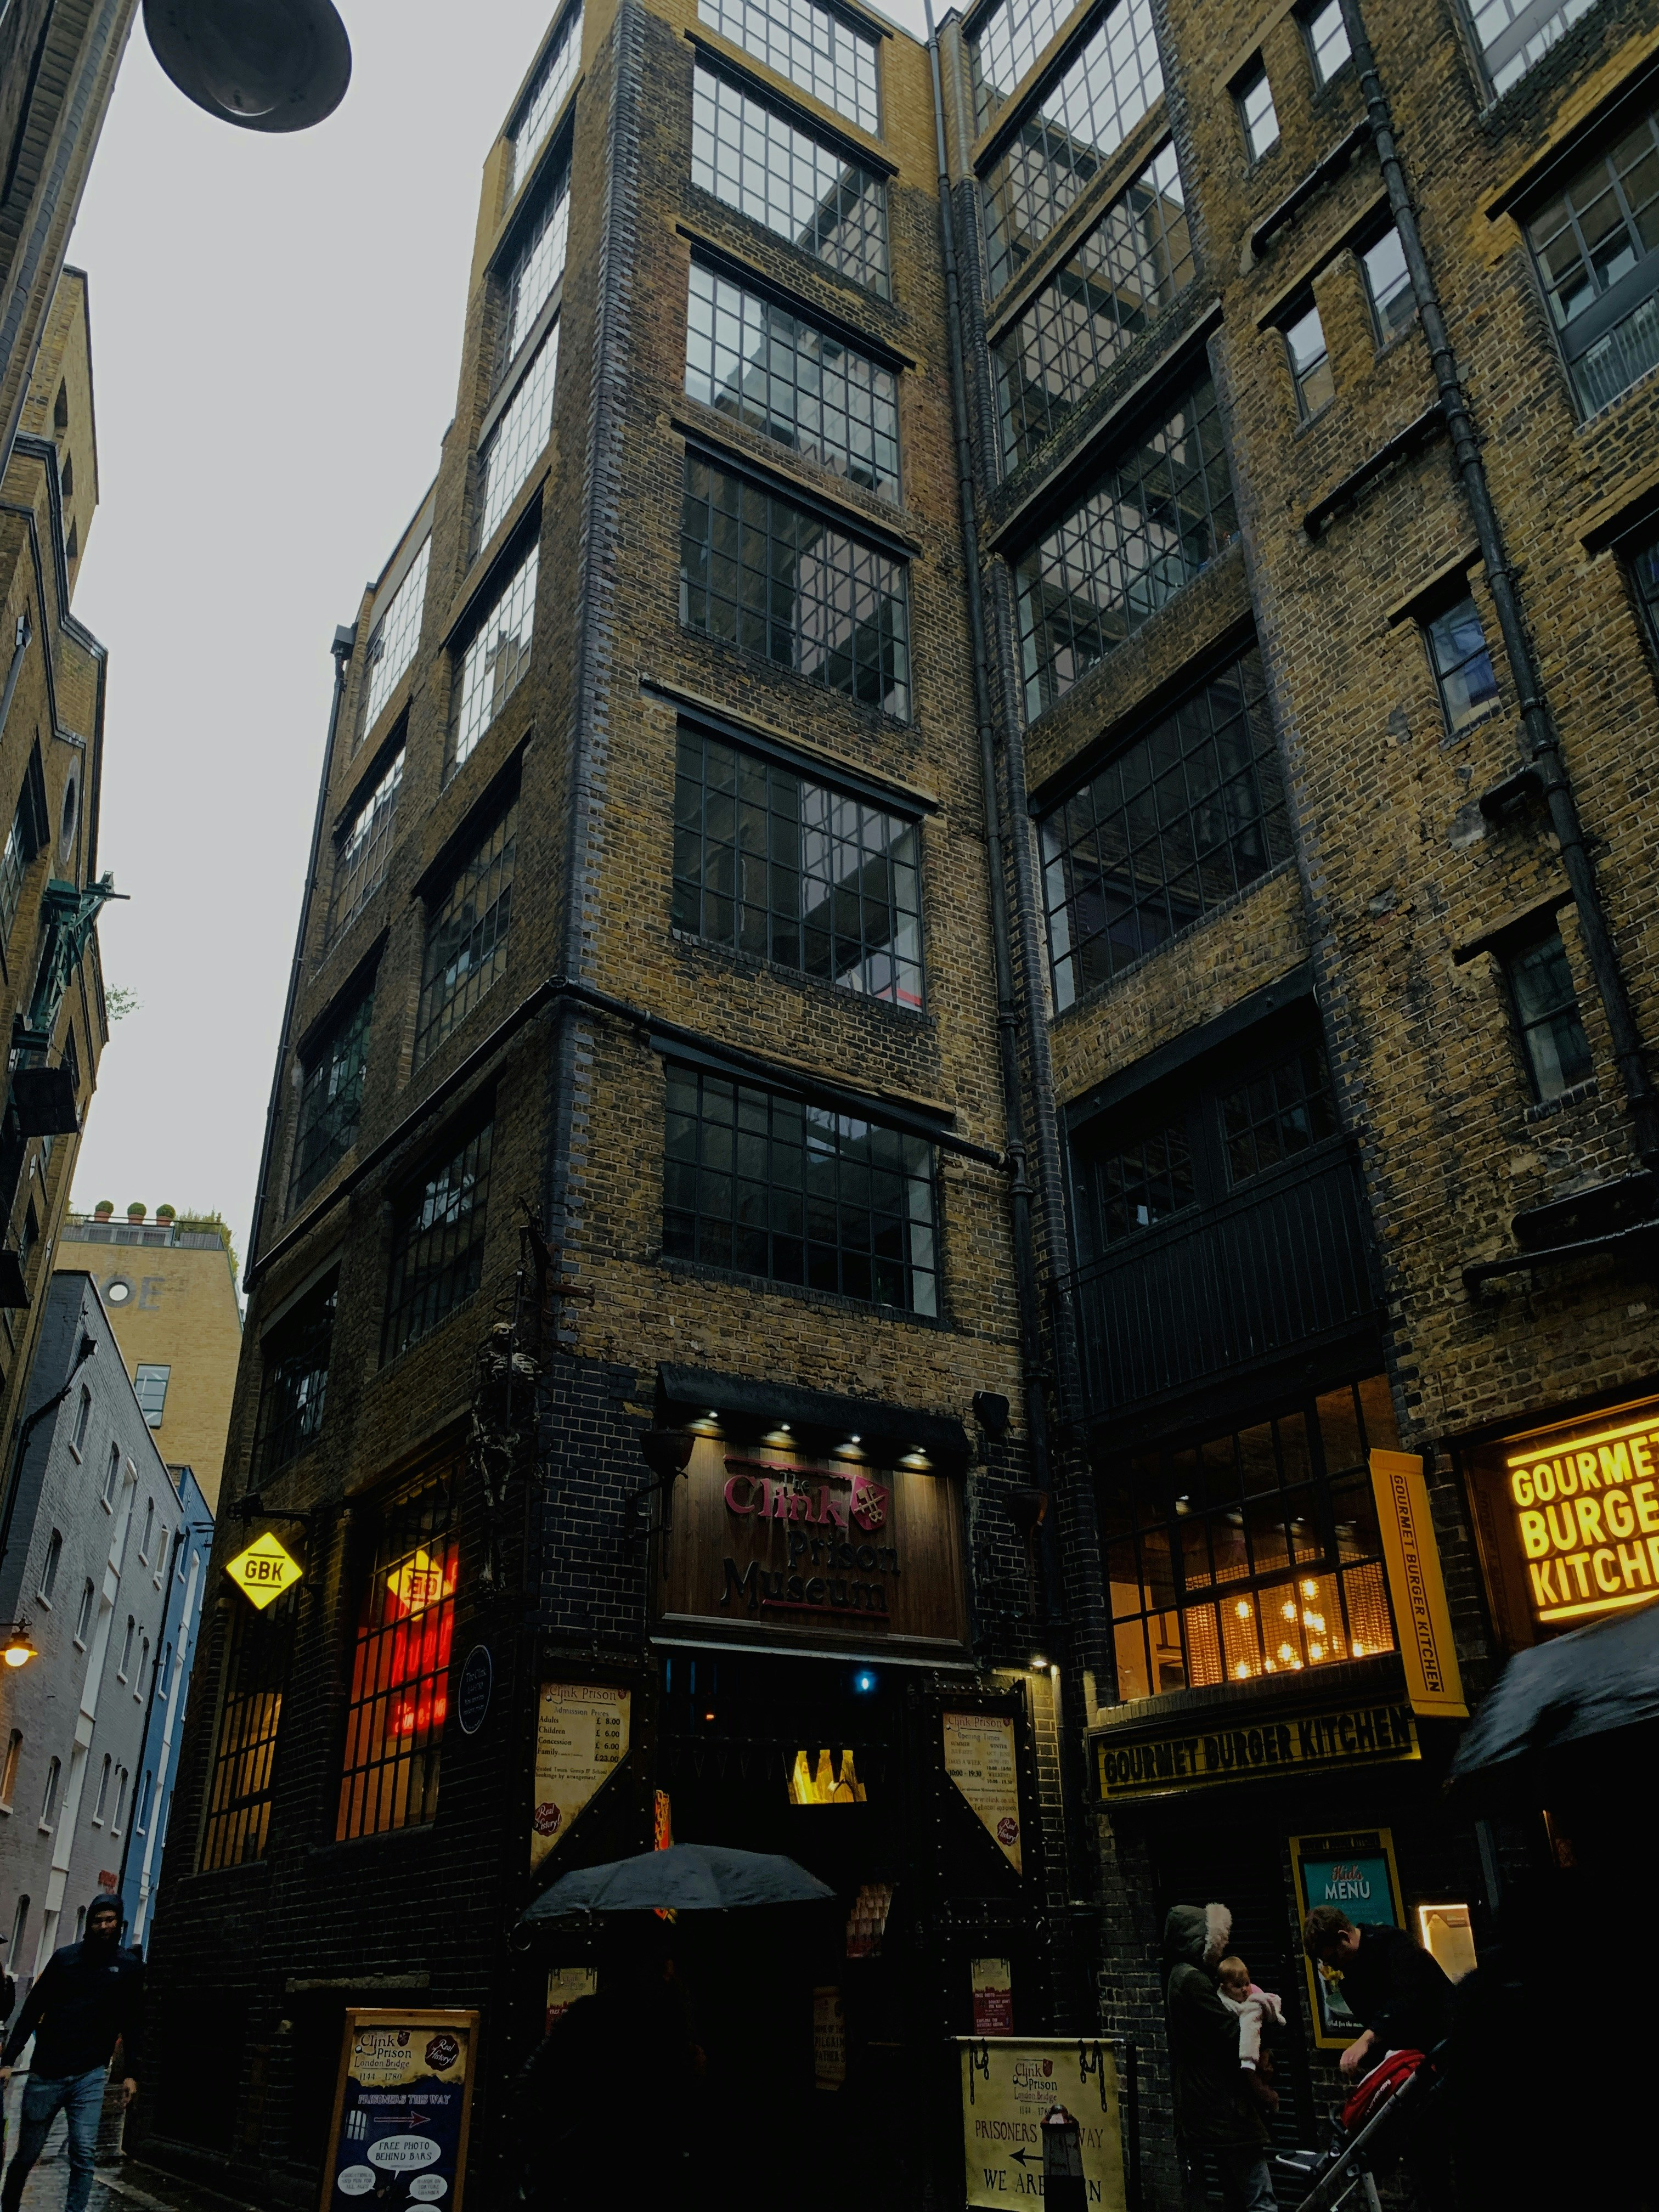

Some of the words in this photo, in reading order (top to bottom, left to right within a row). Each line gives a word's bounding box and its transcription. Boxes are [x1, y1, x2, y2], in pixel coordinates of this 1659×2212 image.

[94, 1274, 165, 1310] OE
[780, 1472, 809, 1490] The
[724, 1475, 848, 1527] Clink
[1519, 1481, 1659, 1558] BURGE
[788, 1530, 901, 1575] Prison
[245, 1560, 284, 1581] GBK
[720, 1558, 888, 1611] Museum
[1393, 1475, 1414, 1546] GOURMET
[1406, 1554, 1425, 1615] BURGER
[1417, 1622, 1440, 1692] KITCHEN
[550, 1685, 578, 1697] Clink
[583, 1688, 617, 1700] Prison
[554, 1707, 588, 1716] Admission
[948, 1717, 971, 1726] Clink
[974, 1717, 1002, 1728] Prison
[539, 1726, 566, 1734] Children
[538, 1737, 572, 1745] Concession
[958, 1732, 980, 1742] Opening
[1104, 1738, 1198, 1784] GOURMET
[1203, 1724, 1292, 1771] BURGER
[1298, 1705, 1412, 1757] KITCHEN
[537, 1804, 555, 1817] Real
[1325, 1881, 1370, 1899] MENU
[360, 2035, 395, 2047] Clink
[438, 2039, 455, 2052] Real
[377, 2049, 411, 2058] Prison
[354, 2056, 383, 2068] London
[386, 2058, 410, 2069] Bridge
[1015, 2063, 1042, 2077] Clink
[385, 2073, 402, 2081] 1780
[1029, 2078, 1058, 2091] Prison
[358, 2094, 407, 2104] PRISONERS
[408, 2094, 428, 2104] THIS
[429, 2094, 452, 2104] WAY
[975, 2120, 1037, 2143] PRISONERS
[379, 2142, 400, 2150] FREE
[404, 2142, 430, 2150] PHOTO
[409, 2152, 432, 2160] BARS
[984, 2169, 1007, 2191] WE
